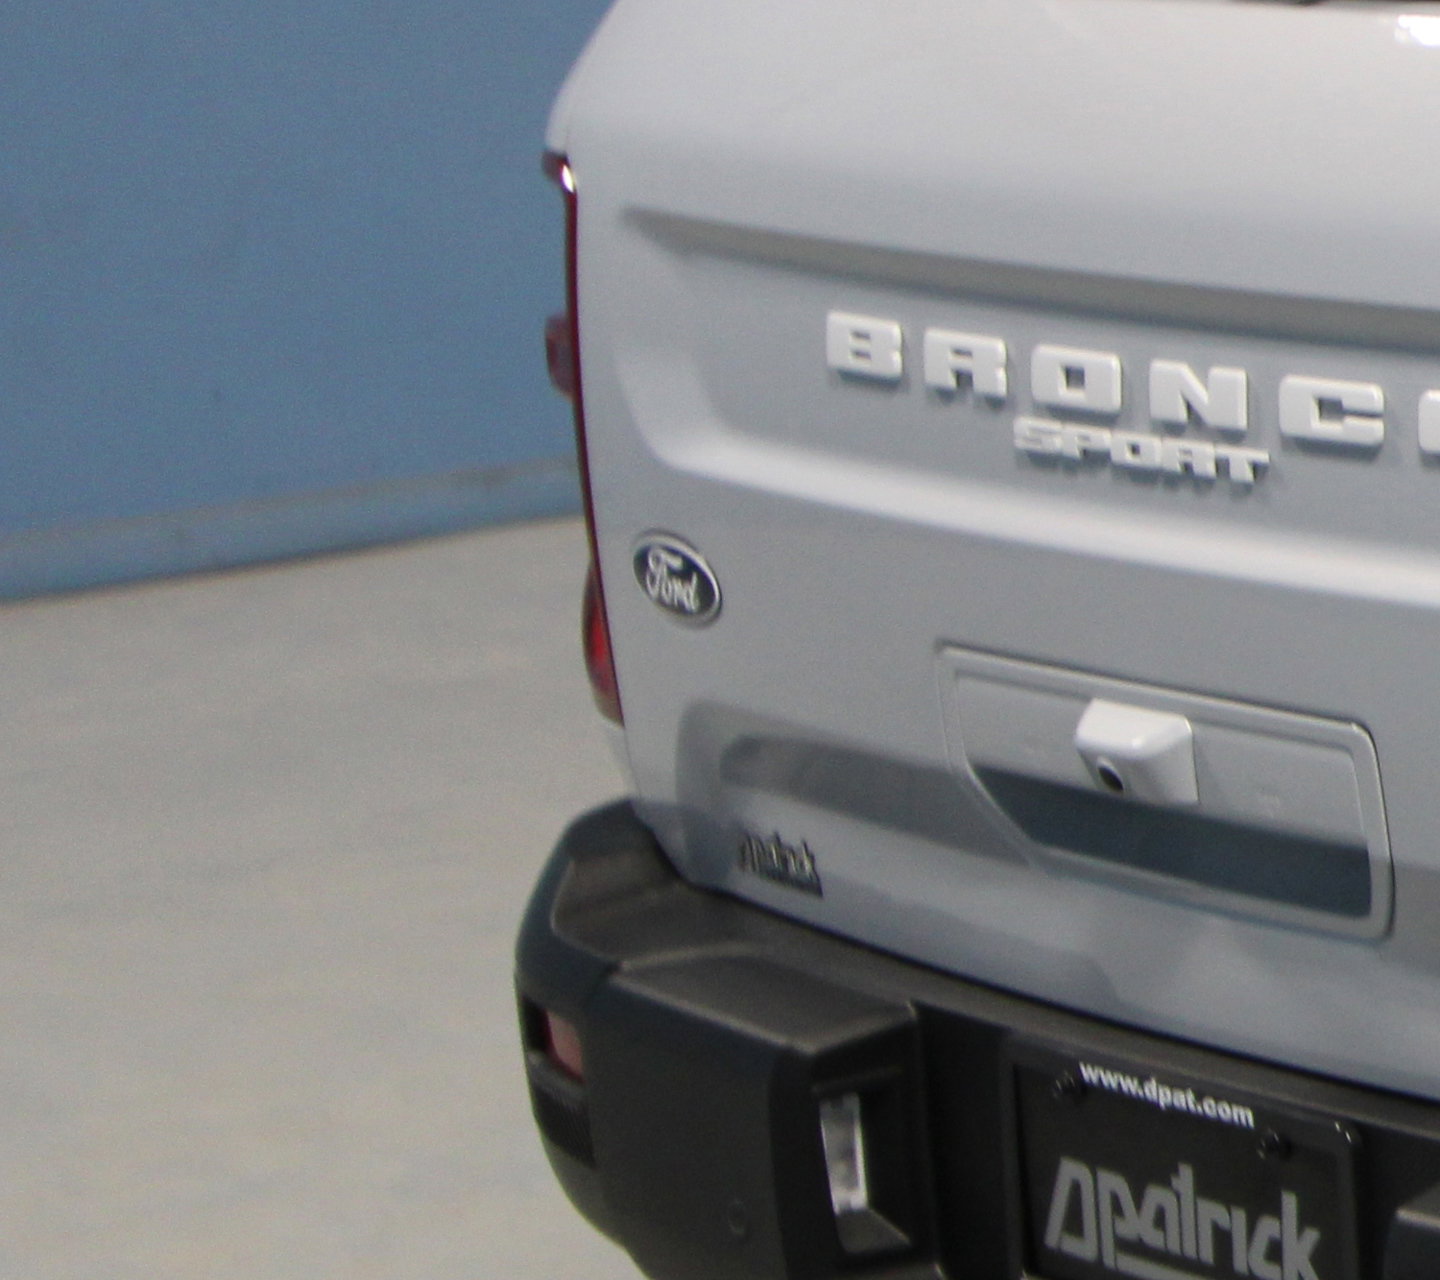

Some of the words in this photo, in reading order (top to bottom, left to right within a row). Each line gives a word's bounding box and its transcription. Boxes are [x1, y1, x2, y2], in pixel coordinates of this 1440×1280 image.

[1012, 417, 1270, 485] SPORT
[645, 546, 698, 613] Ford
[1079, 1061, 1255, 1129] www.dpat.com
